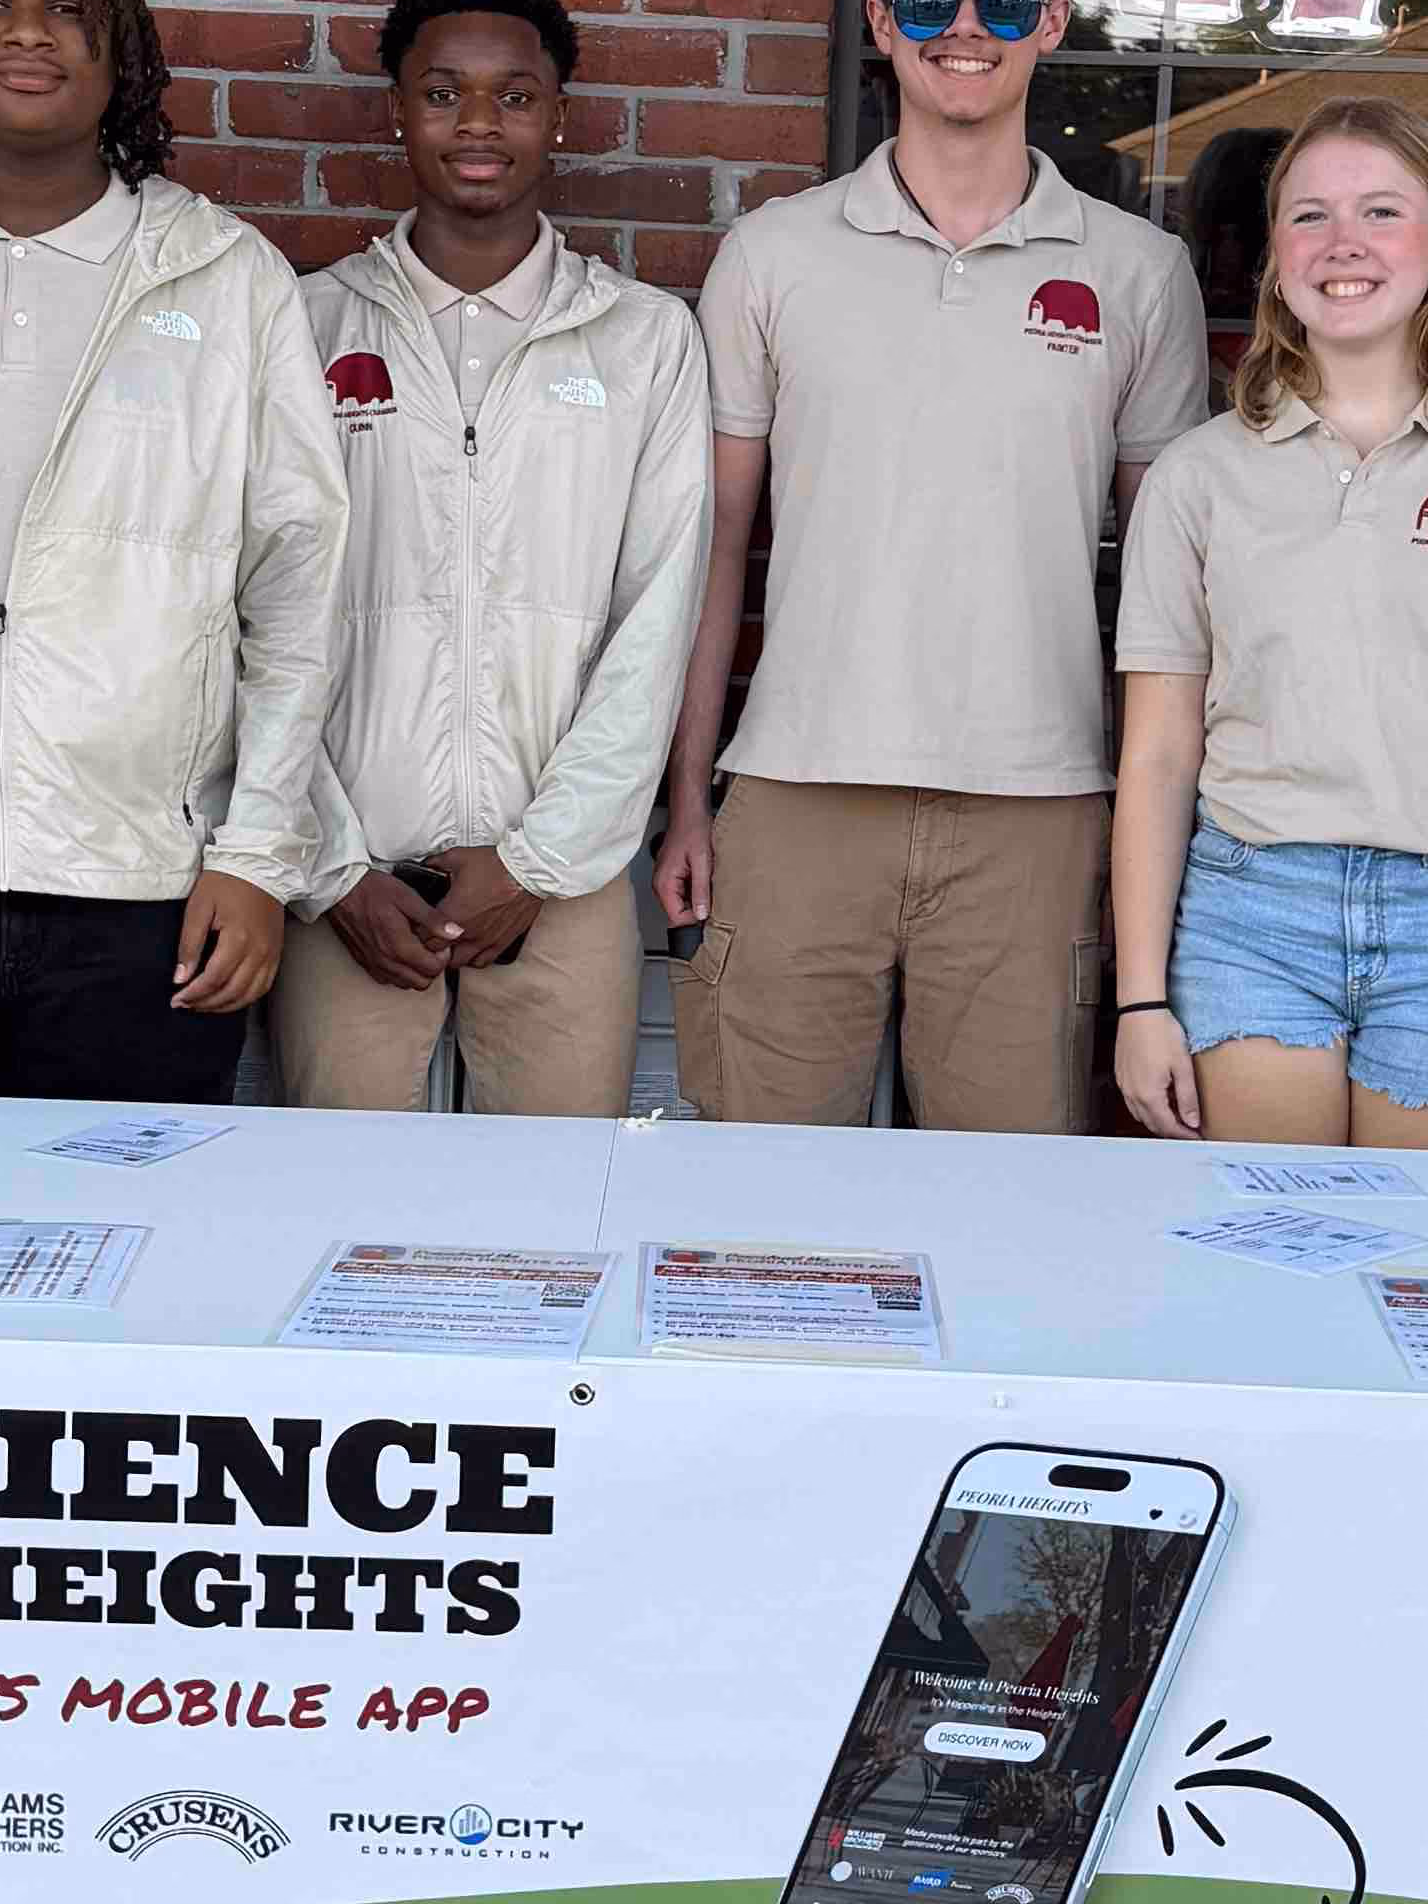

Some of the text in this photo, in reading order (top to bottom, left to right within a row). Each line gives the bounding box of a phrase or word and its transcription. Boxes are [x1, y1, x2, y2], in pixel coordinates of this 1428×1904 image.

[956, 1489, 1093, 1515] PEORIA HEIGHTS
[914, 1670, 1101, 1706] Welcome to Peoria Heights
[60, 1676, 332, 1730] MOBILE
[356, 1685, 491, 1734] APP
[945, 1698, 997, 1715] Happening
[1007, 1704, 1024, 1717] the
[937, 1731, 1032, 1752] DISCOVER NOW
[107, 1799, 281, 1860] CRUSENS
[329, 1812, 585, 1841] RIVER CITY
[36, 1842, 65, 1855] INC.
[360, 1845, 550, 1859] CONSTRUCTION
